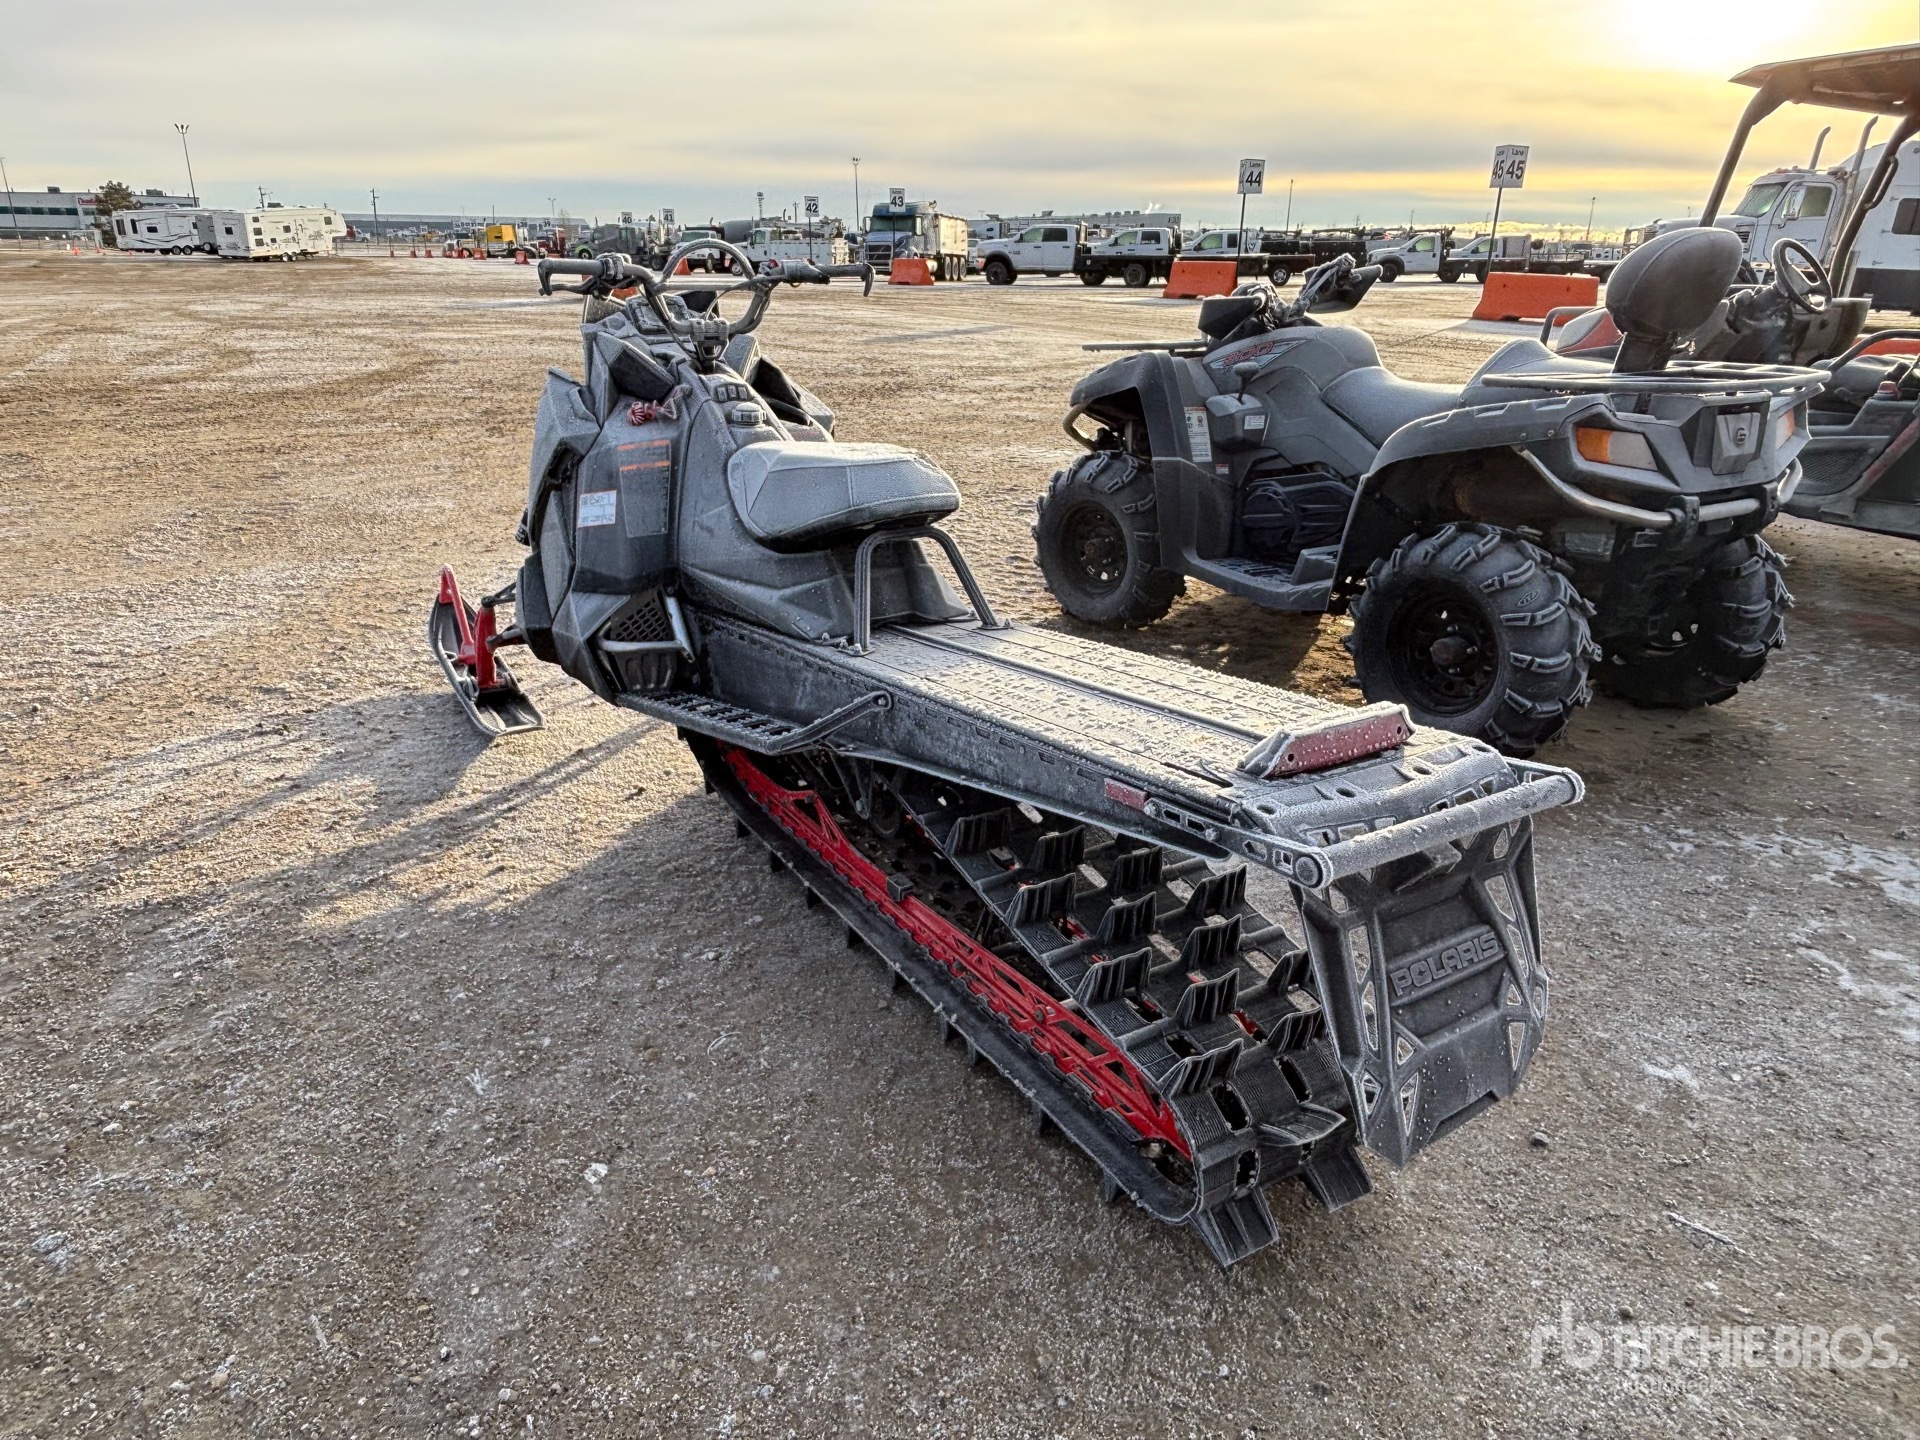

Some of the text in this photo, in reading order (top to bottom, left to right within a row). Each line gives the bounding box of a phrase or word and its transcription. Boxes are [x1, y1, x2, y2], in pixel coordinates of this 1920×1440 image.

[1505, 159, 1526, 180] 45
[1245, 170, 1262, 187] 44
[890, 196, 904, 207] 43
[806, 203, 818, 214] 42
[622, 215, 633, 224] 40
[664, 213, 674, 223] 41
[1390, 931, 1498, 996] POLARIS
